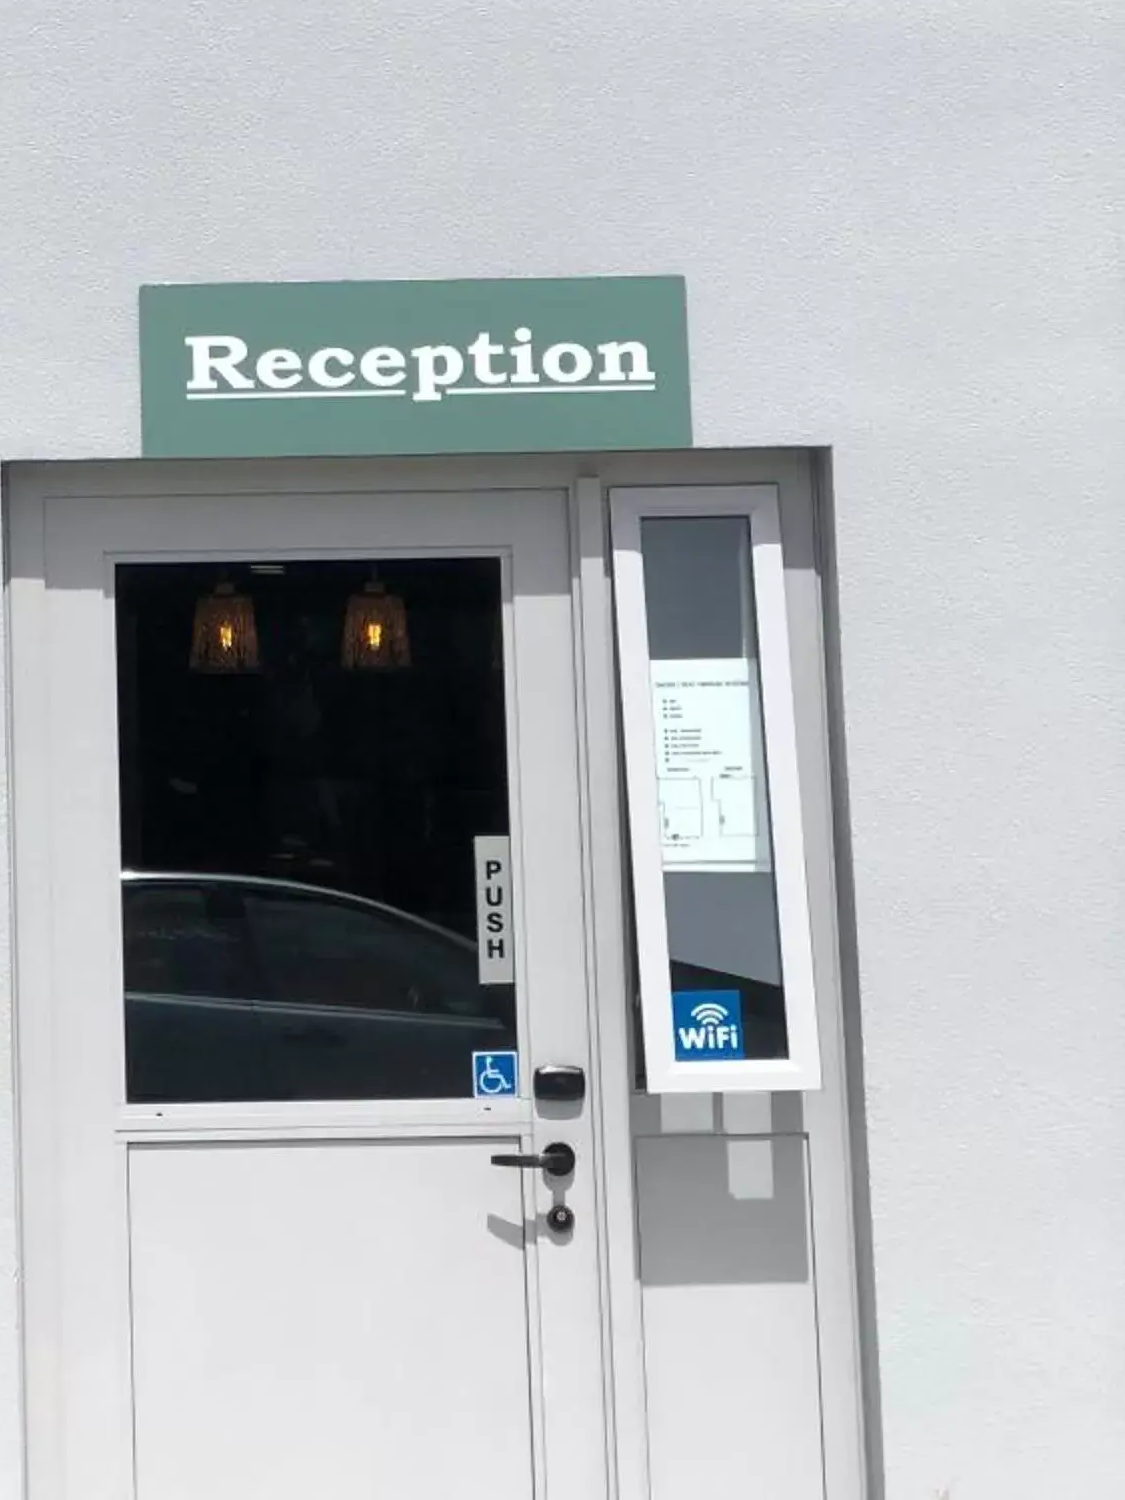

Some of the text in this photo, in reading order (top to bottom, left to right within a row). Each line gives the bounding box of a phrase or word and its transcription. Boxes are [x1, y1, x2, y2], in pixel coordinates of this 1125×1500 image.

[185, 328, 656, 401] Reception
[485, 860, 505, 959] PUSH
[678, 1023, 739, 1051] WiFi
